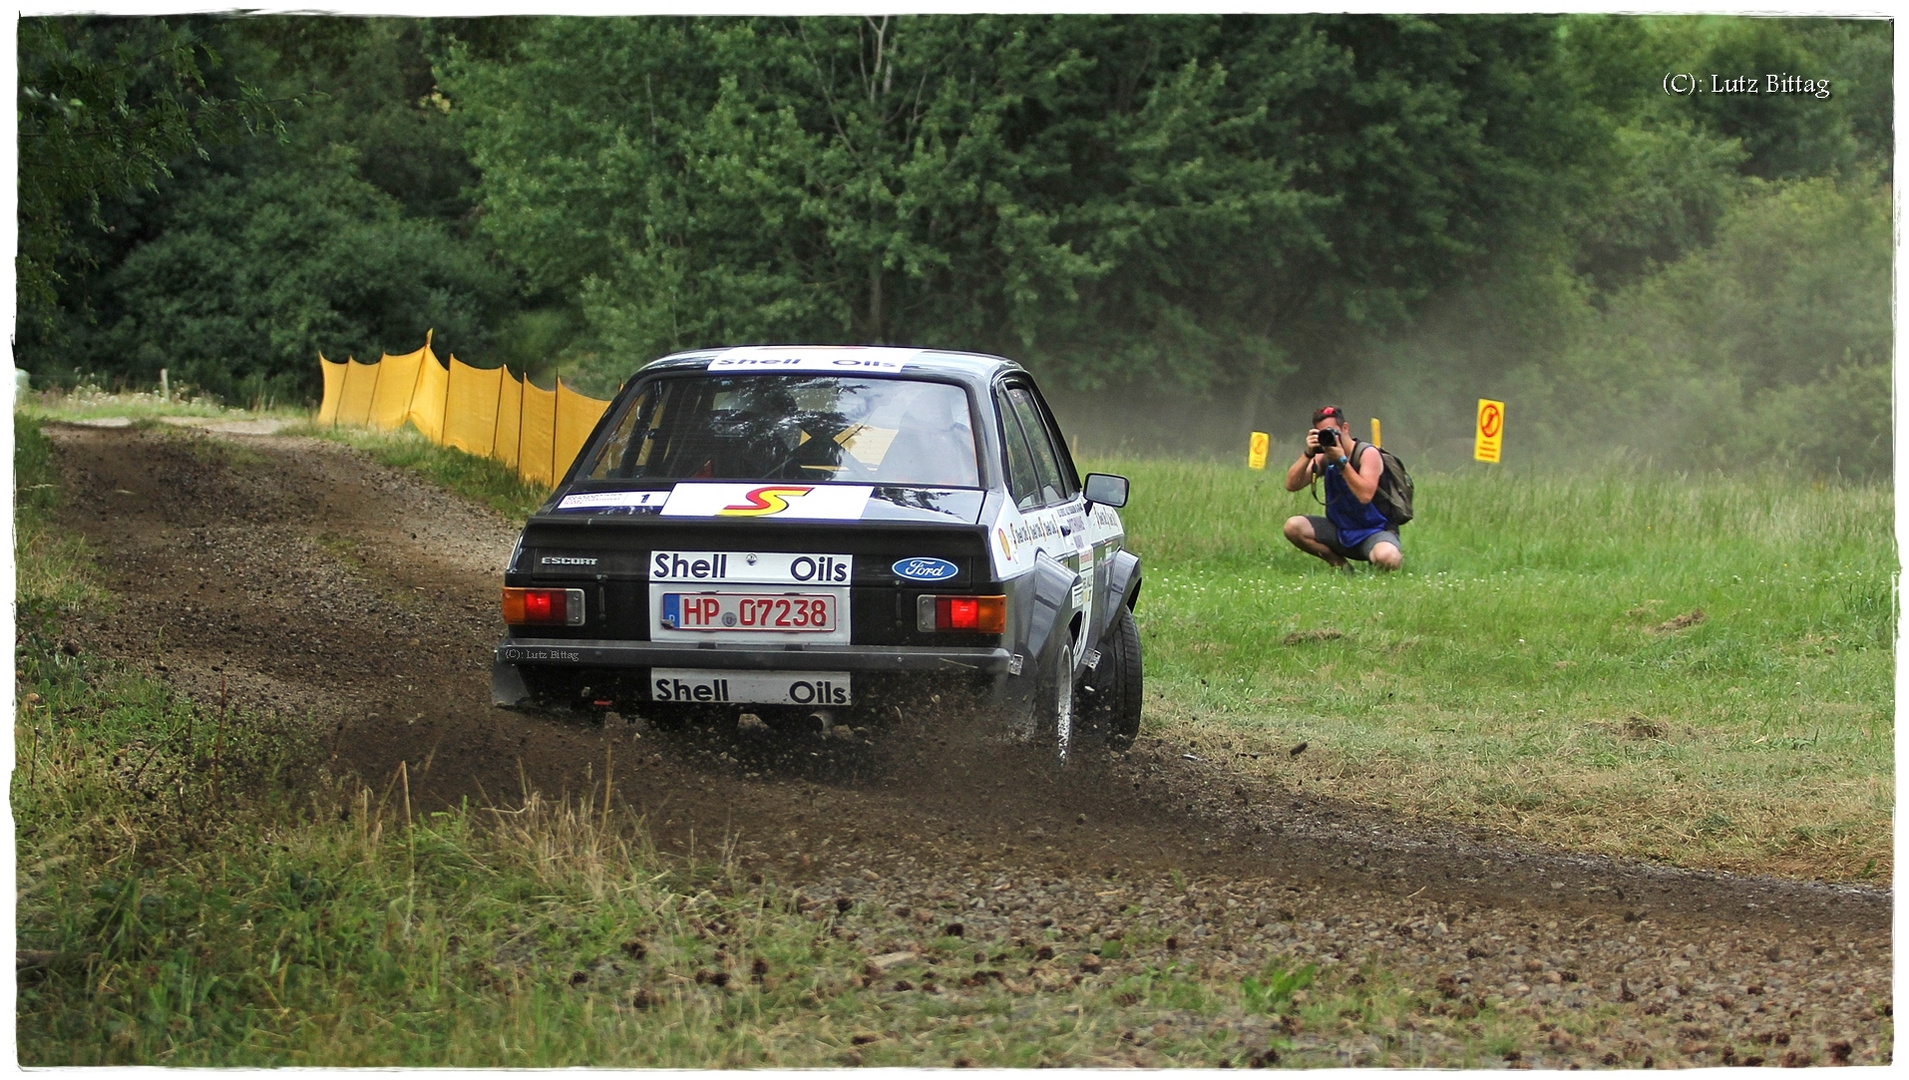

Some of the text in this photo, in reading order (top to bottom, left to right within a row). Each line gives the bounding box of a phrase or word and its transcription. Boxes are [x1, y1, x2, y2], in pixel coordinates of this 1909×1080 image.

[832, 359, 896, 367] Oils
[640, 494, 650, 504] 1
[541, 556, 598, 565] ESCORT
[653, 553, 848, 582] Shell Oils
[905, 559, 945, 577] Ford
[683, 598, 827, 627] HP 07238
[656, 678, 846, 703] Shell Oils
